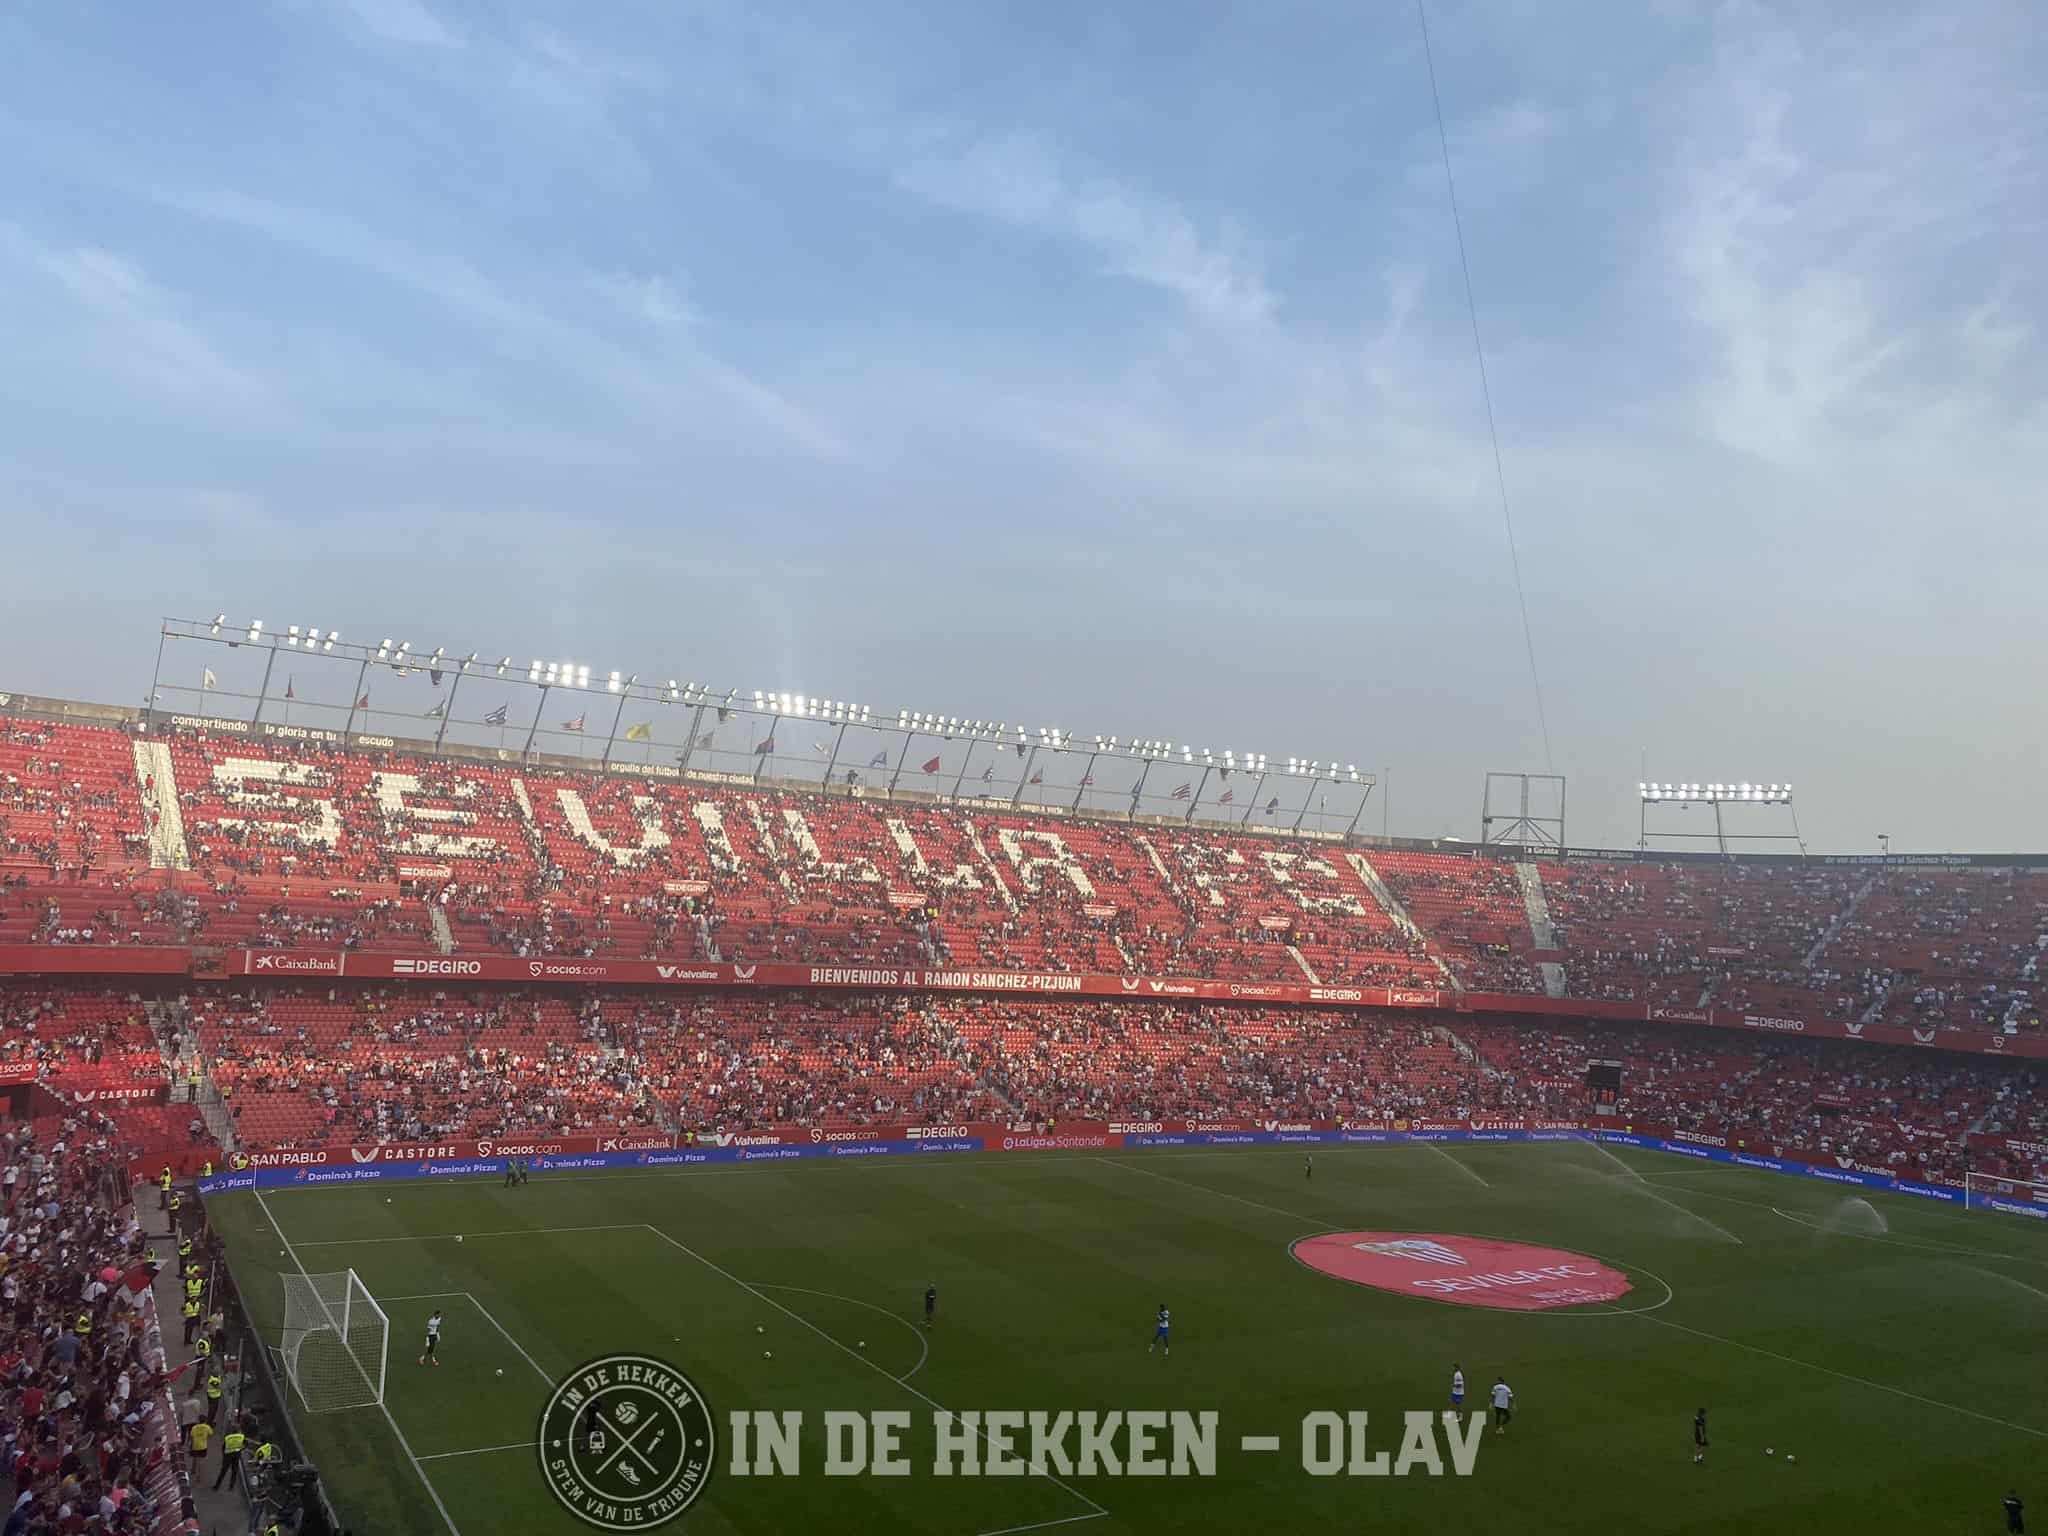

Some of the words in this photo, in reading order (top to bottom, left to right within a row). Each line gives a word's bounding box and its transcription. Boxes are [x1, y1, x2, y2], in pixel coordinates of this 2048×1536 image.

[171, 714, 248, 733] compartiendo
[265, 723, 275, 735] la
[277, 725, 308, 740] gloria
[311, 730, 324, 741] en
[325, 731, 337, 742] tu
[358, 735, 395, 748] escudo
[412, 868, 451, 878] DEGIRO
[275, 955, 337, 971] CaixaBank
[415, 959, 481, 974] DEGIRO
[676, 970, 719, 980] Valvoline
[810, 968, 899, 986] BIENVENIDOS
[902, 970, 919, 986] AL
[924, 971, 970, 987] RAMON
[972, 974, 1081, 991] SANCHEZ-PIZJUAN
[1323, 990, 1362, 1002] DEGIRO
[1758, 1015, 1805, 1032] DEGIRO
[99, 1088, 157, 1100] CASTORE
[921, 1127, 968, 1139] DEGIRO
[1122, 1122, 1163, 1133] DEGIRO
[618, 1137, 671, 1150] CaixaBank
[734, 1134, 780, 1147] Valvoline
[1014, 1137, 1047, 1147] LaLiga
[1056, 1134, 1106, 1148] Santander
[1687, 1131, 1727, 1147] DEGIRO
[249, 1153, 279, 1167] SAN
[282, 1151, 327, 1165] PABLO
[384, 1145, 456, 1161] CASTORE
[647, 1153, 683, 1164] Domino's
[685, 1152, 706, 1162] Pizza
[430, 1164, 471, 1175] Domino's
[473, 1163, 497, 1173] Pizza
[583, 1158, 606, 1167] Pizza
[307, 1171, 353, 1182] Domino's
[354, 1169, 380, 1178] Pizza
[1854, 1161, 1897, 1178] Valvoline
[227, 1177, 253, 1188] Pizza
[1410, 1270, 1560, 1294] SEVILLA
[1540, 1265, 1598, 1281] FC
